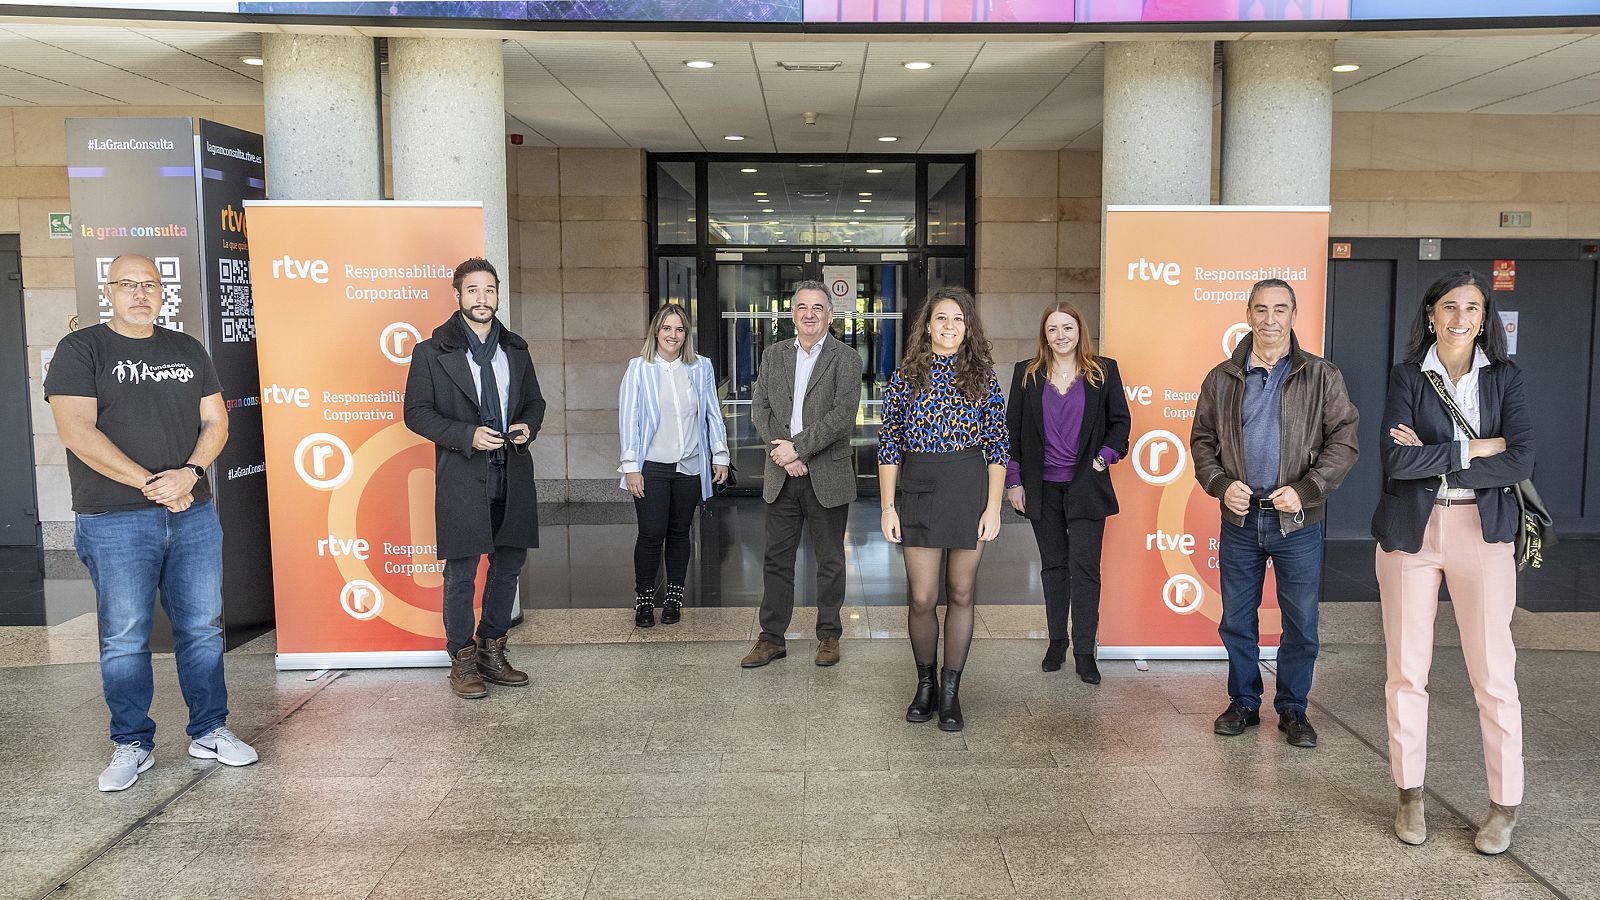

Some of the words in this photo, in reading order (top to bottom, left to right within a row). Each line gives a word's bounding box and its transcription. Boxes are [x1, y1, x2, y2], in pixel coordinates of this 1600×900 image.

[88, 138, 174, 151] #LaGranConsulta
[206, 141, 262, 164] lagranconsulta.rtve.es
[81, 224, 94, 237] la
[97, 226, 128, 240] gran
[130, 224, 188, 237] consulta
[272, 255, 329, 284] rtve
[344, 264, 455, 281] Responsabilida
[1127, 257, 1181, 286] rtve
[1194, 267, 1307, 283] Responsabilidad
[345, 286, 429, 303] Corporativa
[1194, 288, 1252, 304] Corporat
[149, 362, 187, 371] fundación
[263, 383, 311, 408] rtve
[1123, 385, 1153, 405] ve
[1164, 389, 1200, 404] Respo
[226, 398, 243, 412] gran
[243, 396, 261, 407] cons
[323, 408, 394, 423] Corporativa
[1163, 406, 1196, 421] Corpo
[228, 461, 266, 480] #LaGranConsul
[317, 534, 370, 560] rtve
[383, 542, 438, 558] Respons
[1146, 529, 1195, 555] rtve
[384, 560, 446, 577] Corporati
